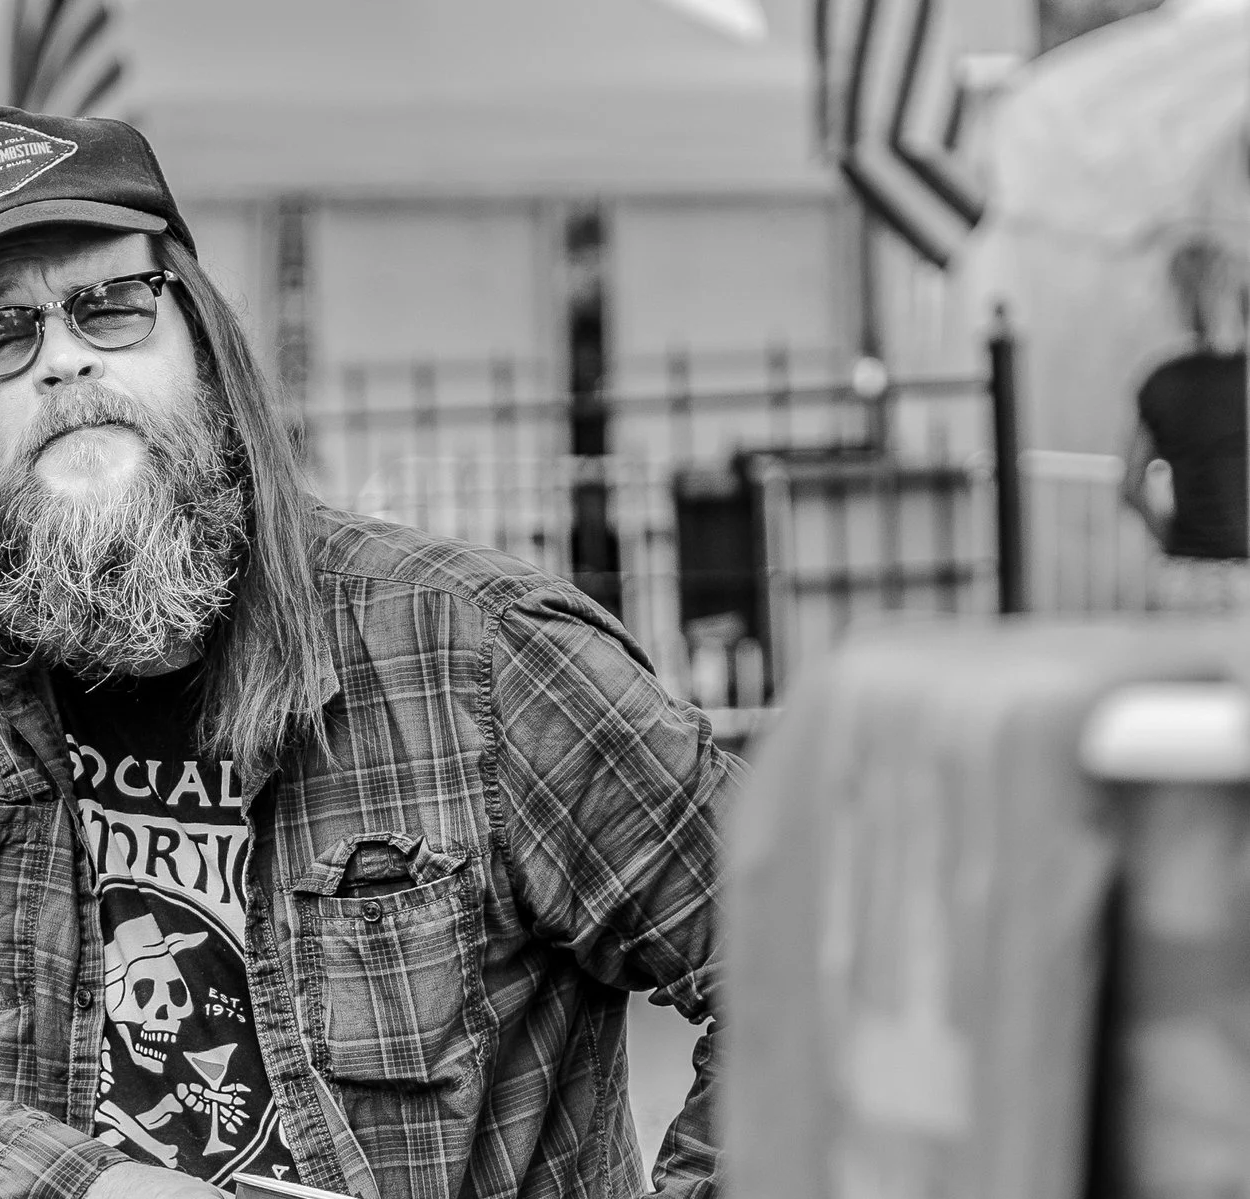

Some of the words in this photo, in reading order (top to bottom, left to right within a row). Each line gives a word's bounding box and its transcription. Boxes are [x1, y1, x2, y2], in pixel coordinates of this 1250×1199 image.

[4, 136, 25, 144] FOLK
[209, 987, 244, 1011] EST.
[205, 1003, 246, 1023] 1979
